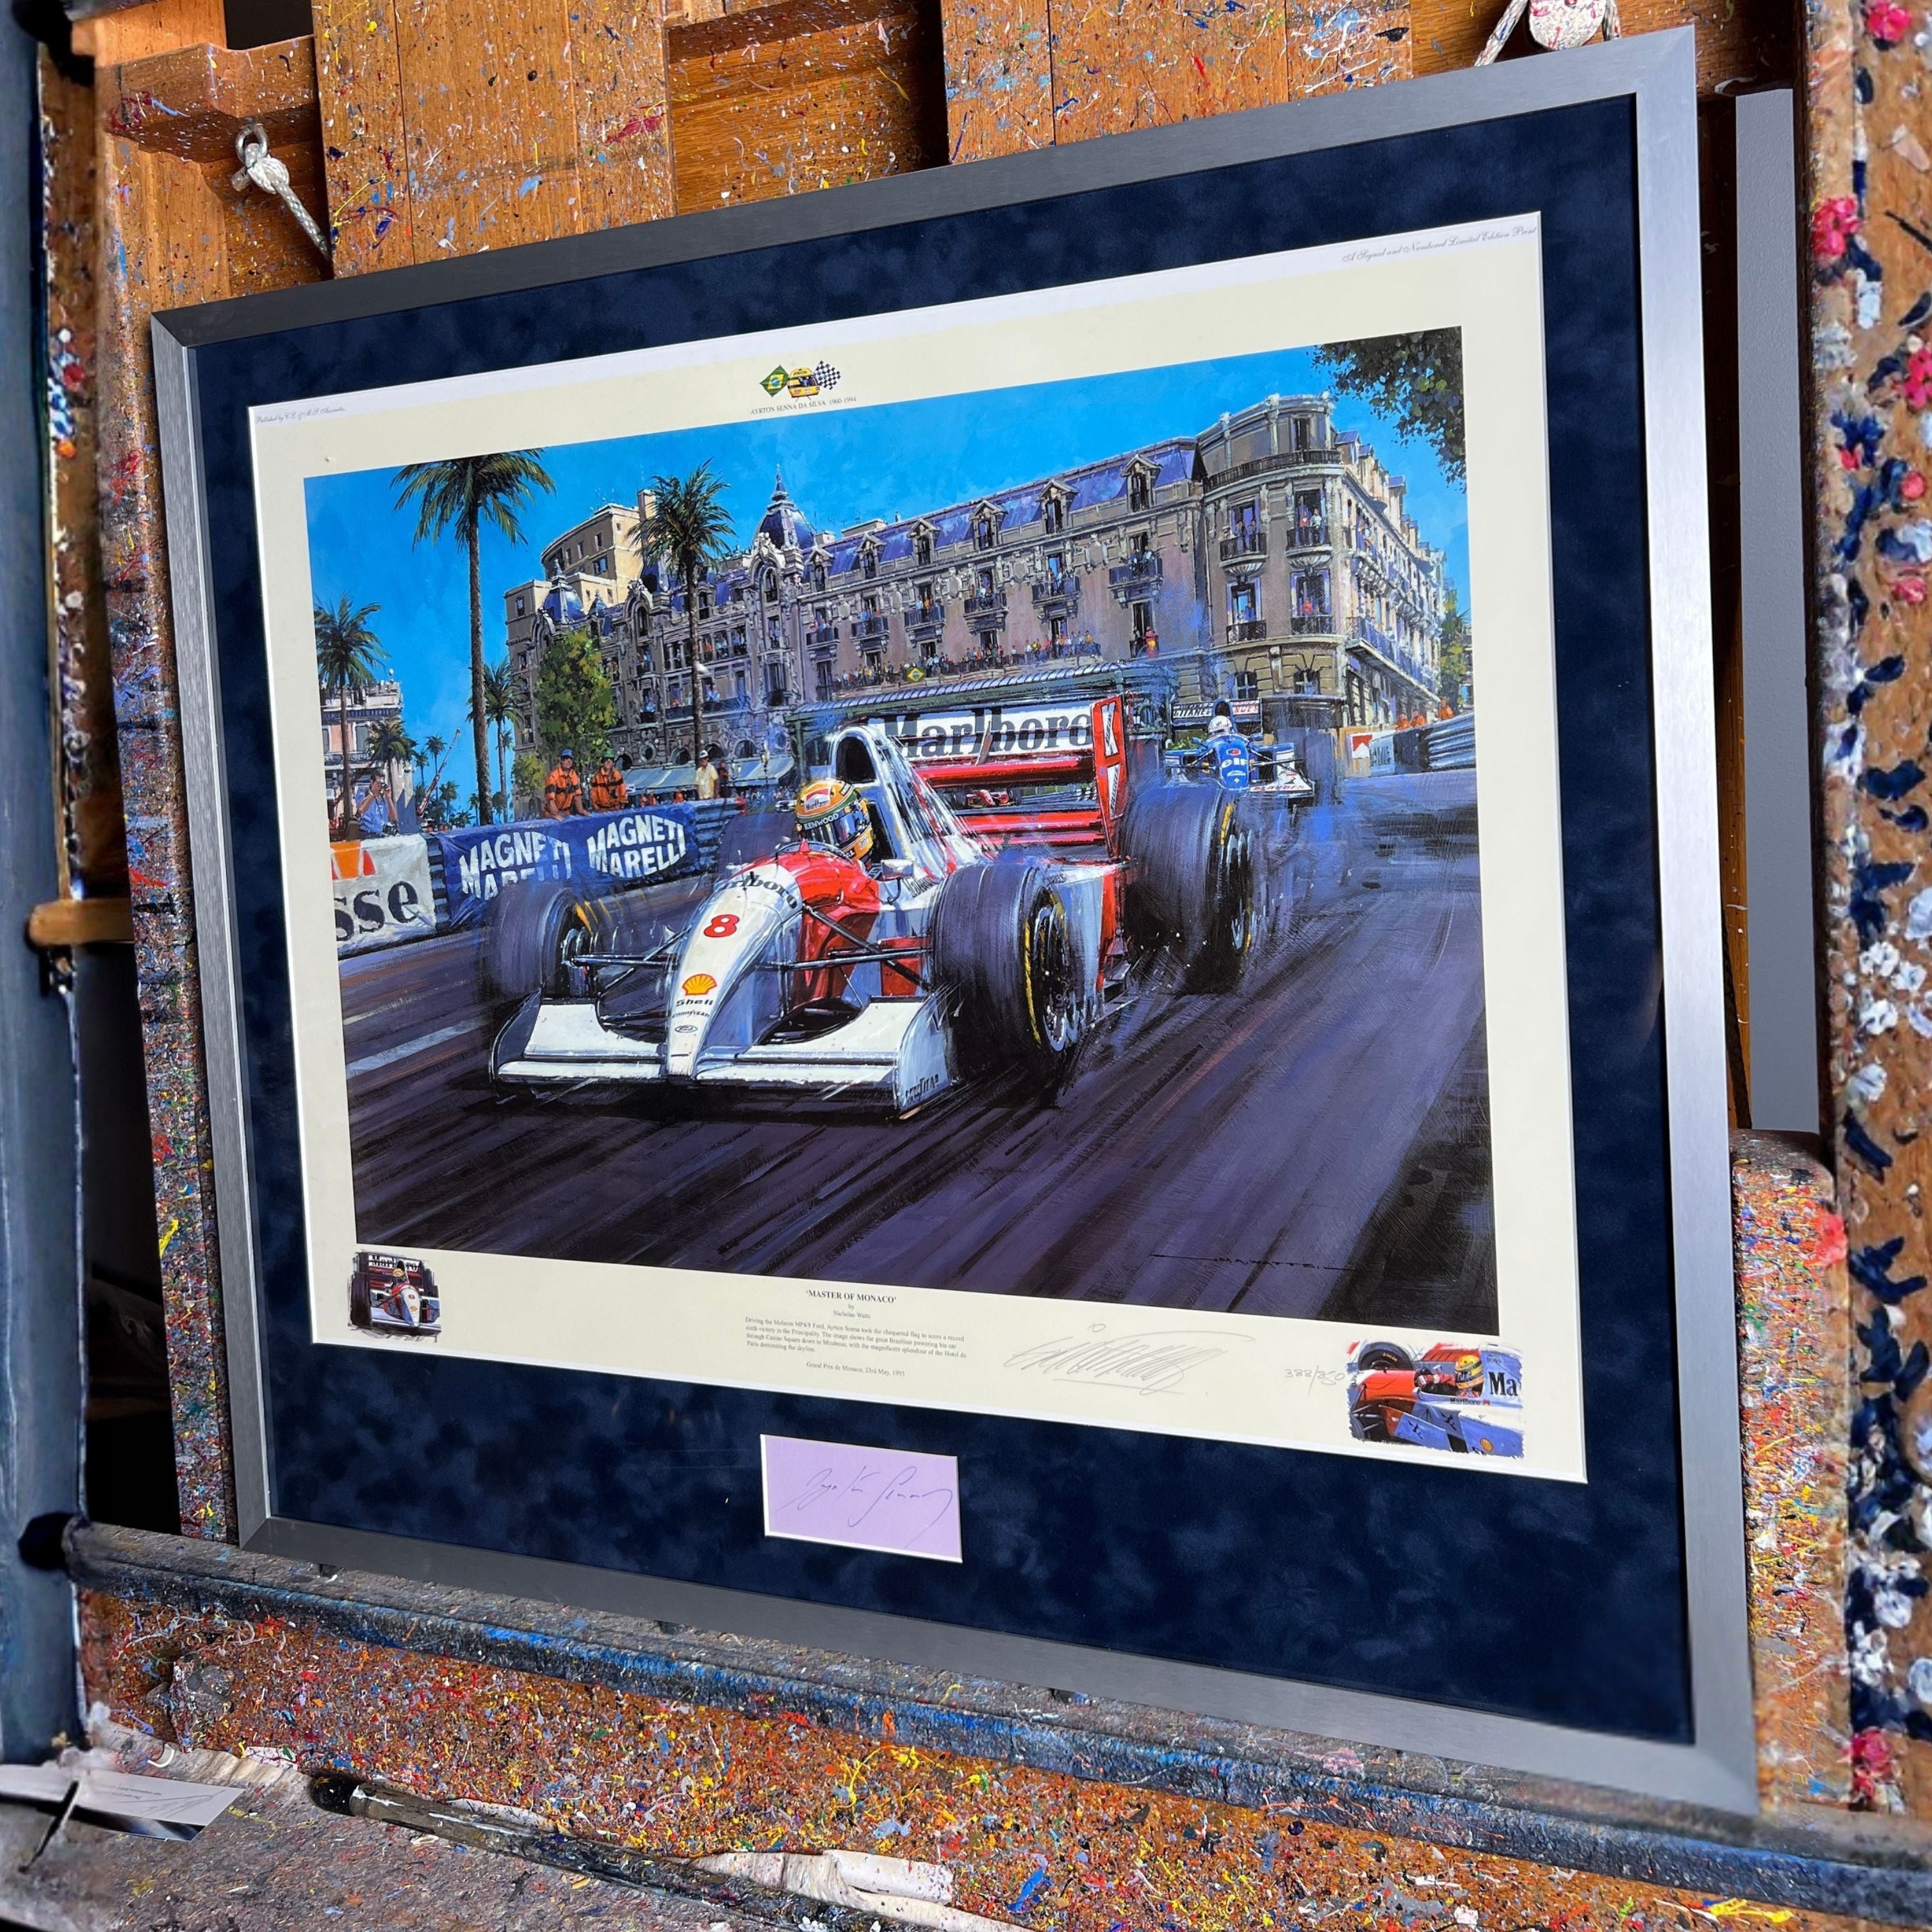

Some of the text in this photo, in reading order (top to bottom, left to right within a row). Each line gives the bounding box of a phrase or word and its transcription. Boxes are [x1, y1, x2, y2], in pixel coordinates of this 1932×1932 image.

[1357, 248, 1386, 262] Signed
[1387, 245, 1402, 256] and
[1403, 238, 1447, 253] Numbered
[1448, 234, 1480, 247] Limited
[1481, 230, 1509, 242] Edition
[1512, 225, 1537, 237] Print
[751, 406, 775, 415] AYRTON
[776, 404, 797, 412] SENNA
[809, 400, 826, 408] SILVA
[884, 707, 1090, 757] Marlboro
[803, 813, 839, 831] KENWOOD
[587, 815, 686, 862] MAGNETI
[587, 839, 686, 878] MARELLI
[703, 914, 740, 938] 8
[676, 999, 714, 1007] Shell
[833, 1310, 855, 1318] Nicholas
[746, 1316, 764, 1325] Driving
[910, 1330, 921, 1339] flag
[759, 1326, 775, 1334] victory
[913, 1340, 938, 1349] powering
[760, 1341, 787, 1351] dominating
[871, 1345, 901, 1353] magnificent
[1449, 1397, 1481, 1406] Marlboro
